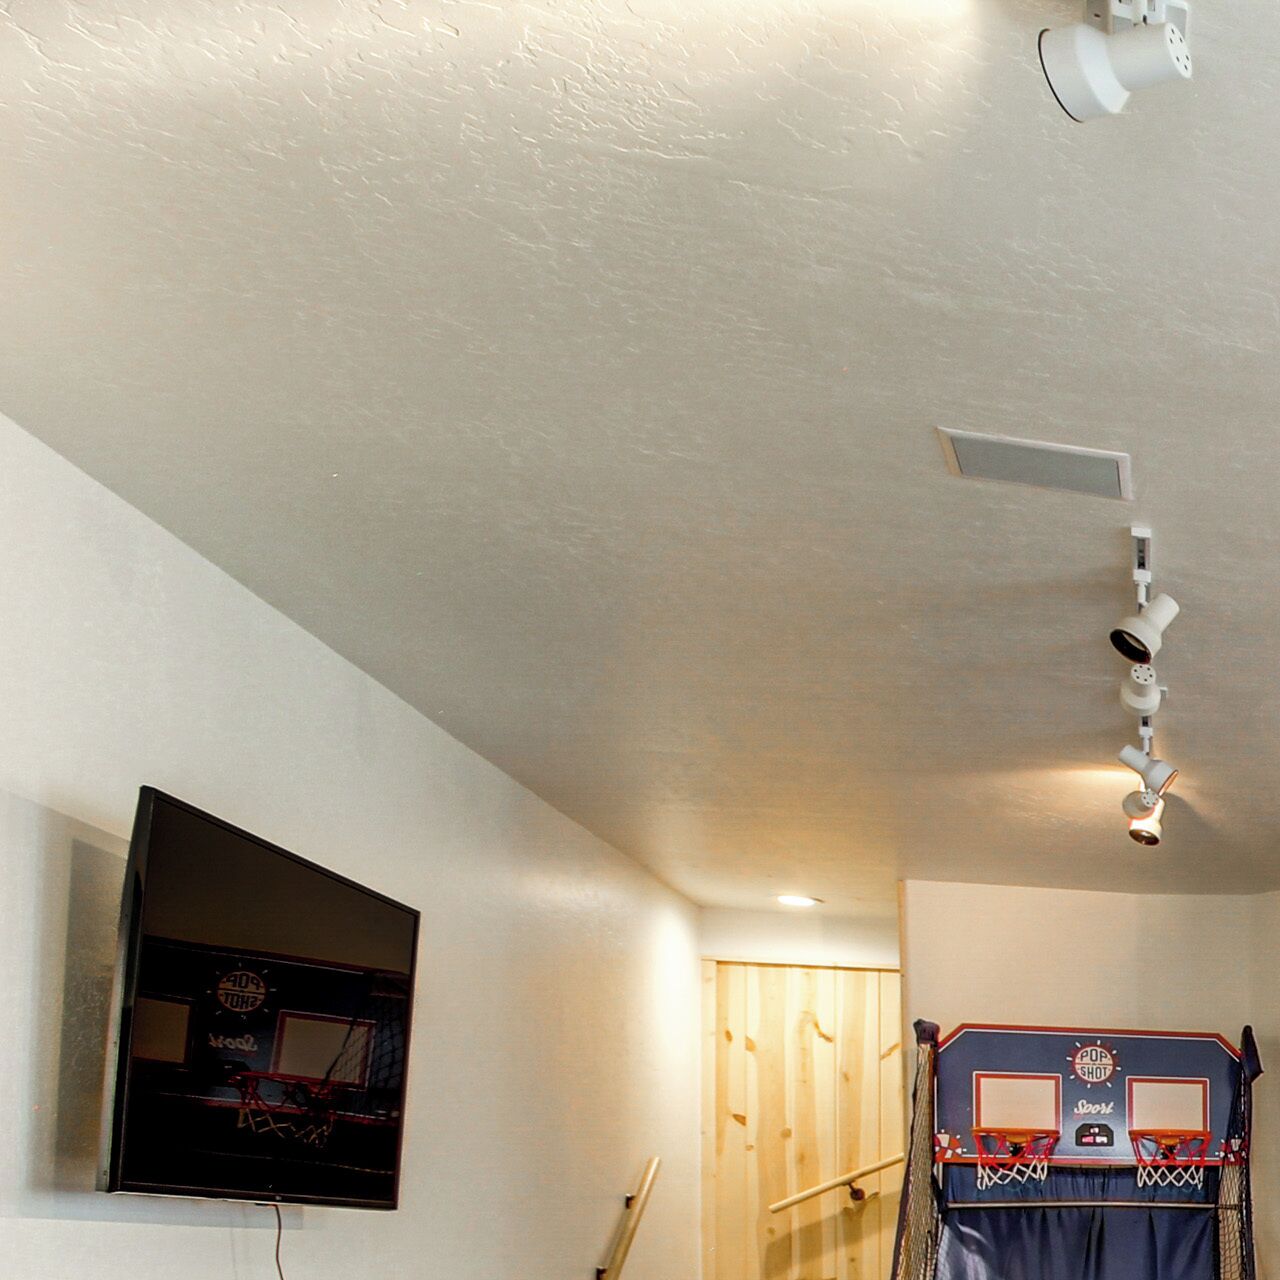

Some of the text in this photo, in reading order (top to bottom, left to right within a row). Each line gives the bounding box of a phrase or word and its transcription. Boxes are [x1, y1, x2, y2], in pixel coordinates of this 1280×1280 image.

[1080, 1048, 1108, 1062] POP
[1080, 1066, 1108, 1080] SHOT
[1074, 1099, 1114, 1115] Sport
